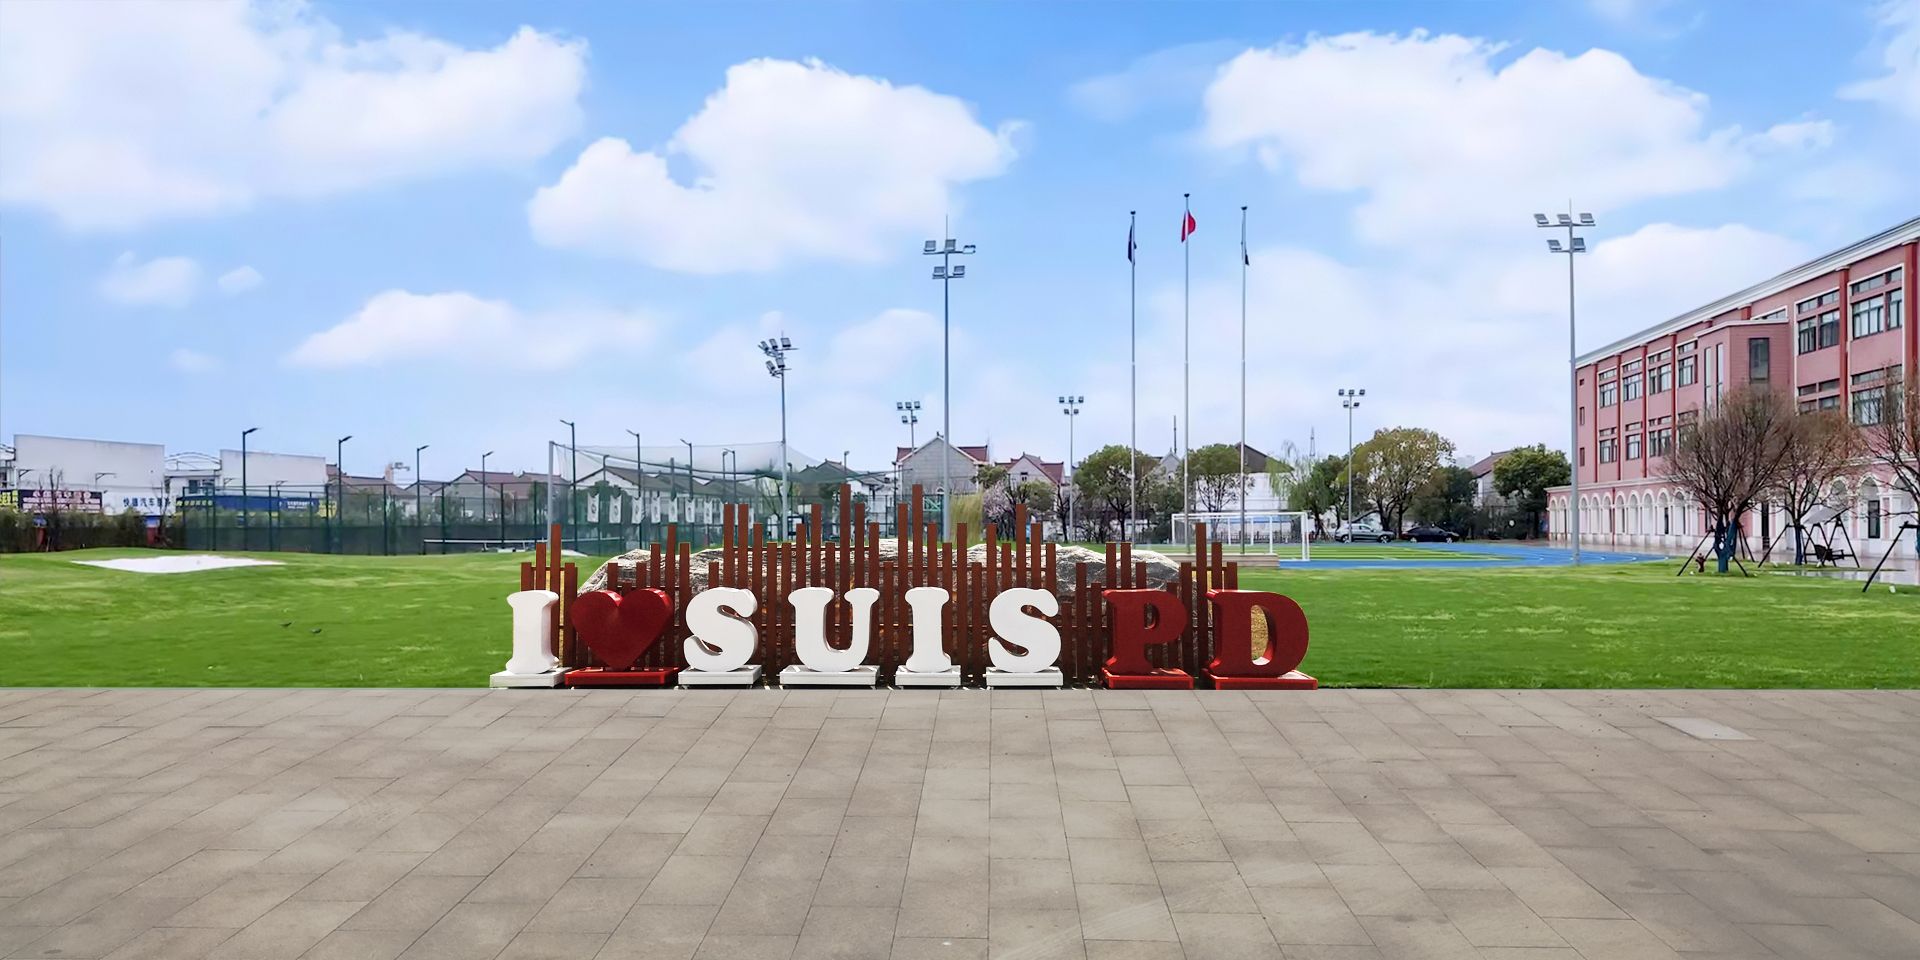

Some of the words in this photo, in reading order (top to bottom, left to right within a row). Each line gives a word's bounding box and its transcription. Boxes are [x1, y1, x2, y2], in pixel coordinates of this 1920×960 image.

[506, 590, 559, 674] I
[684, 587, 1061, 673] SUIS
[1103, 589, 1309, 677] PD
